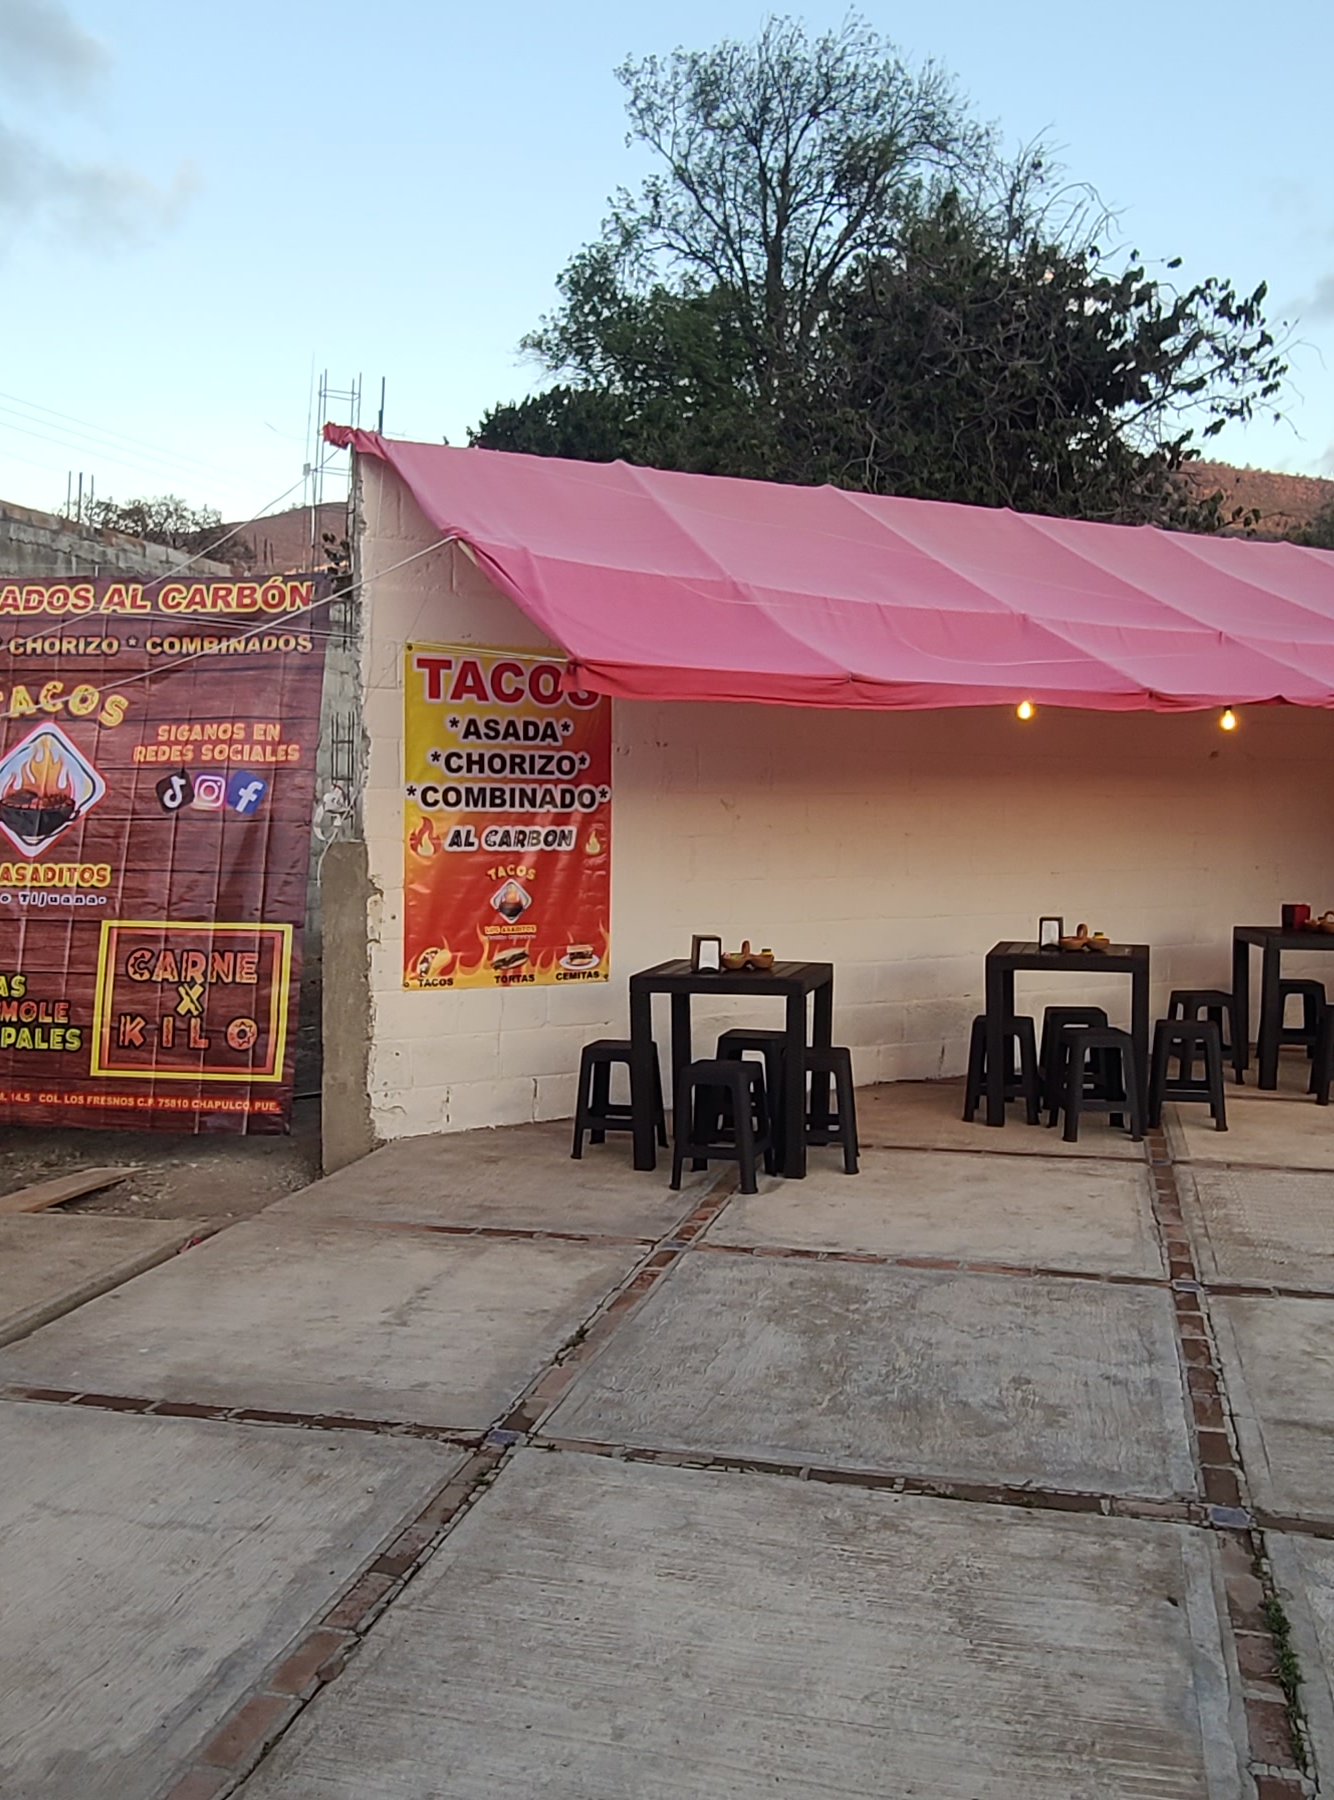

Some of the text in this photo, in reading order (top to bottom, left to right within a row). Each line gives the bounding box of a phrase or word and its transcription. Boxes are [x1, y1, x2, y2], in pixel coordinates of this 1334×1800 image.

[100, 584, 151, 613] AL
[159, 576, 315, 613] CARBÓN
[9, 635, 119, 655] CHORIZO
[146, 634, 313, 655] COMBINADOS
[157, 723, 281, 741] SIGANOS EN
[133, 744, 300, 762] REDES SOCIALES
[448, 828, 574, 849] AL CARBON
[487, 864, 536, 881] TACOS
[127, 949, 259, 984] CARNE
[419, 971, 600, 987] TACOS TORTAS CEMITAS
[176, 983, 204, 1016] X
[64, 1094, 84, 1104] LOS
[86, 1095, 134, 1107] FRESNOS
[158, 1097, 189, 1109] 75810
